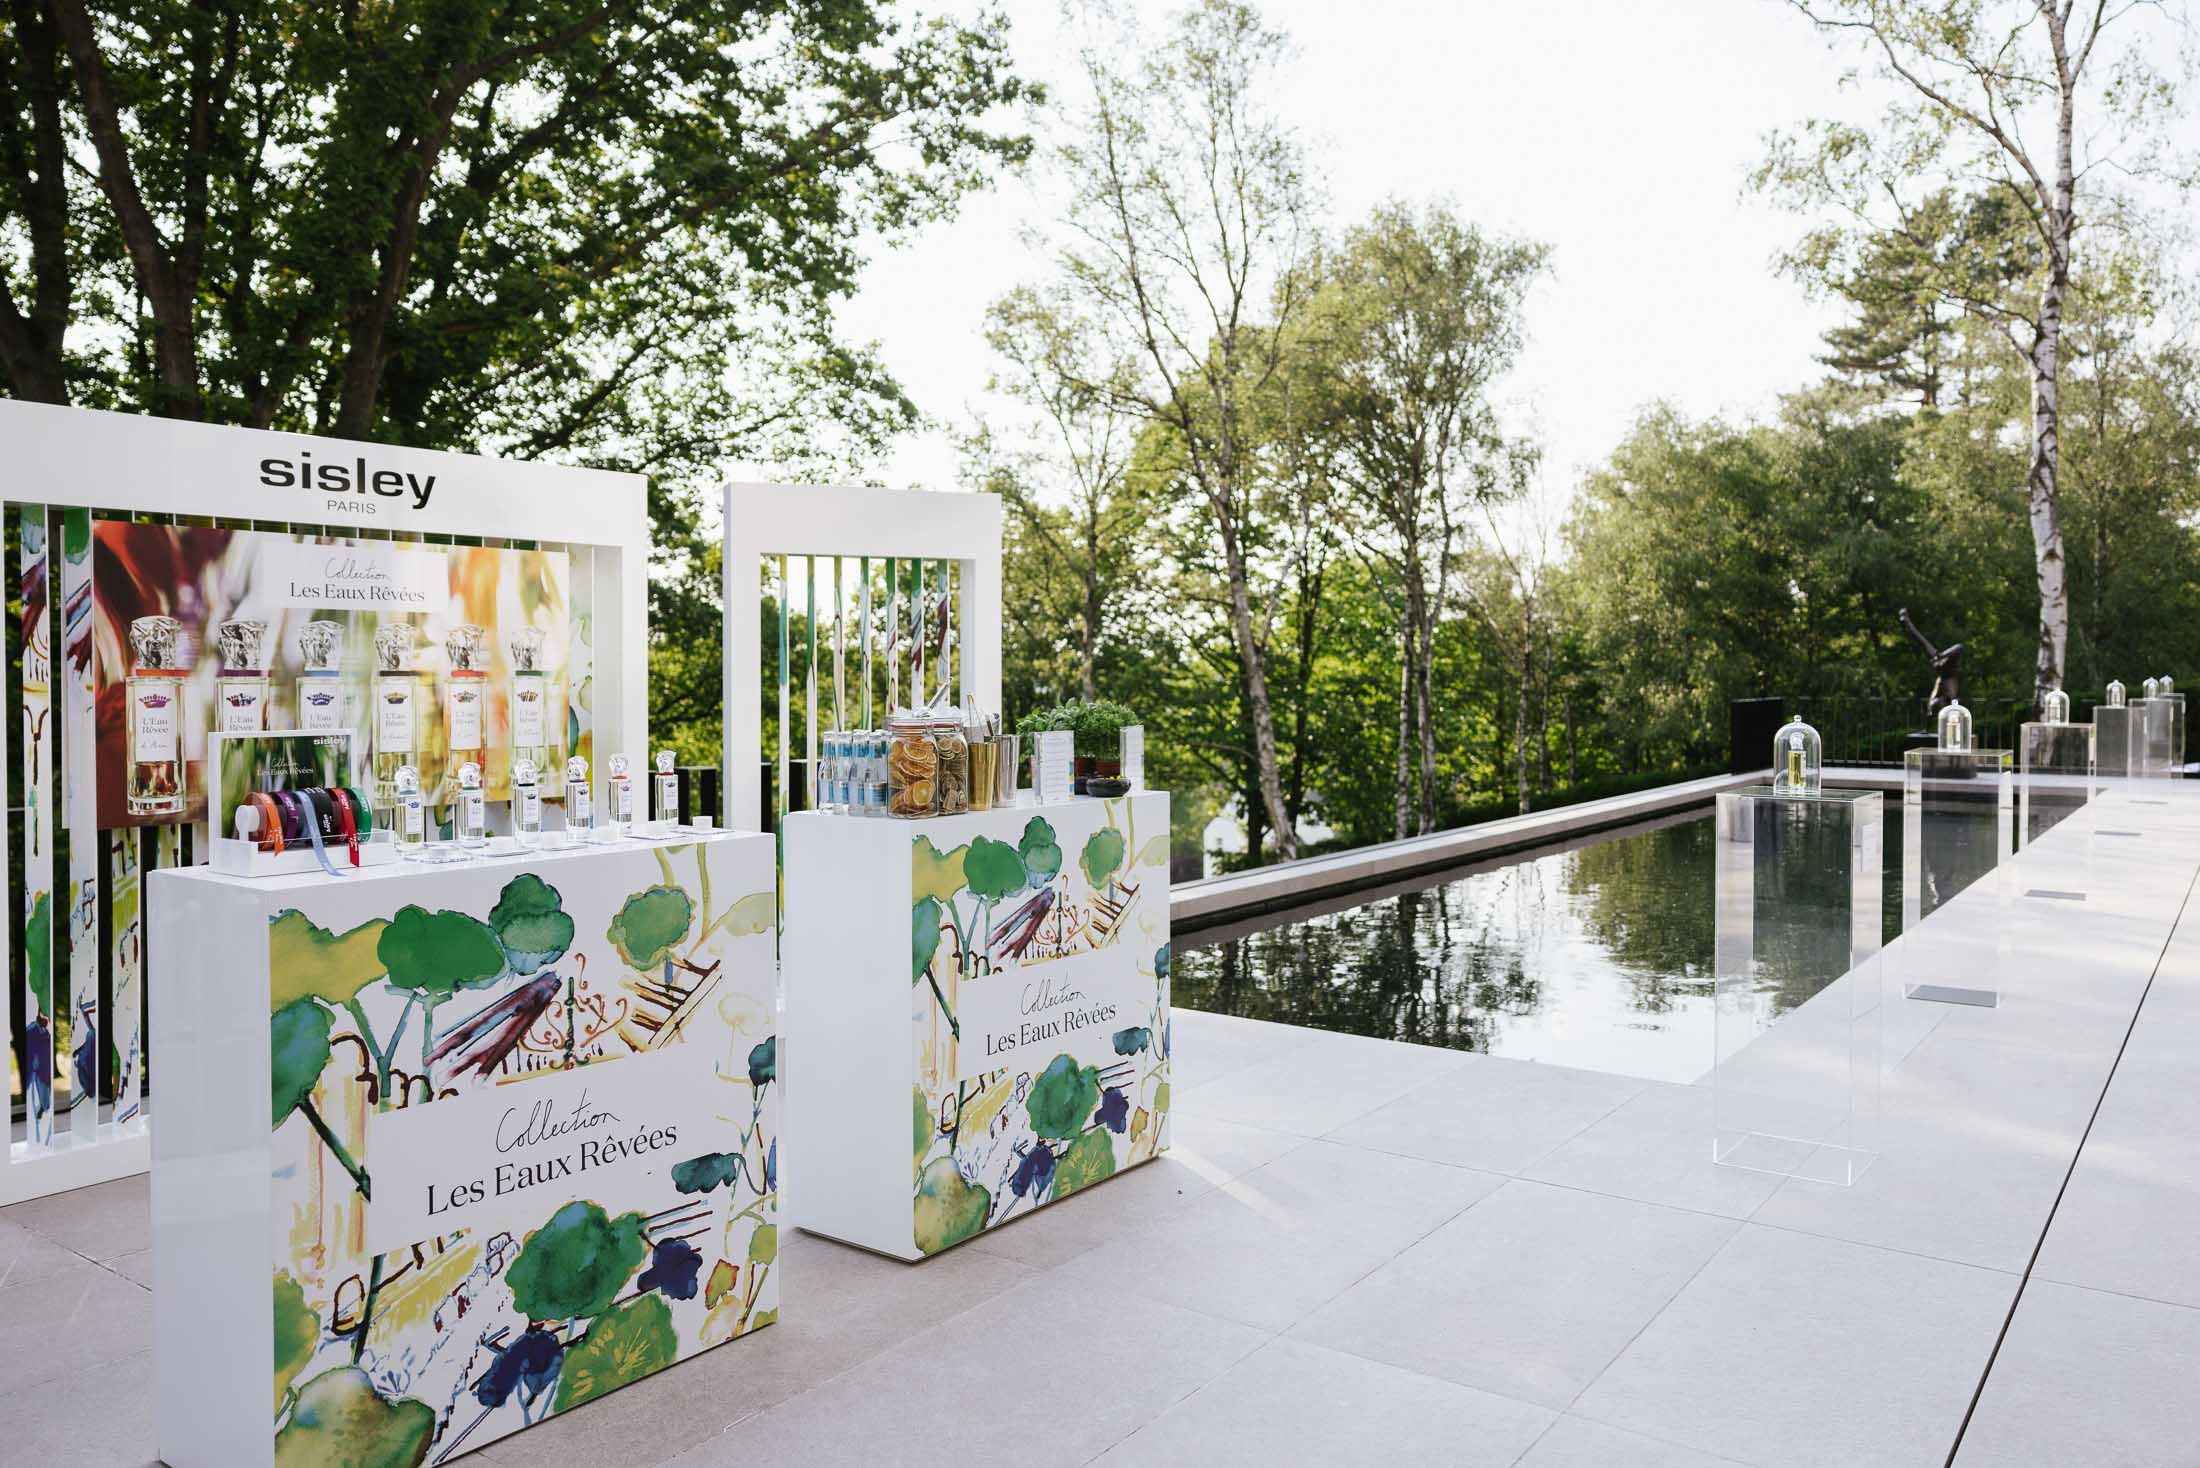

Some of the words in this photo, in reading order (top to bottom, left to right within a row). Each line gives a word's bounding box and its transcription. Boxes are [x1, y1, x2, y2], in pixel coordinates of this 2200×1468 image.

[260, 451, 436, 510] sisley
[327, 499, 377, 514] PARIS
[290, 581, 320, 598] Les
[325, 583, 366, 600] Eaux
[370, 586, 425, 602] Rêvées
[325, 557, 392, 580] Collection
[1021, 969, 1087, 1016] Collection
[986, 1033, 1016, 1056] Les
[1020, 1021, 1061, 1046] Eaux
[1064, 1001, 1117, 1033] Rêvées
[496, 1088, 621, 1153] Collection
[427, 1180, 485, 1216] Les
[494, 1156, 572, 1196] Eaux
[580, 1124, 677, 1171] Rêvées
